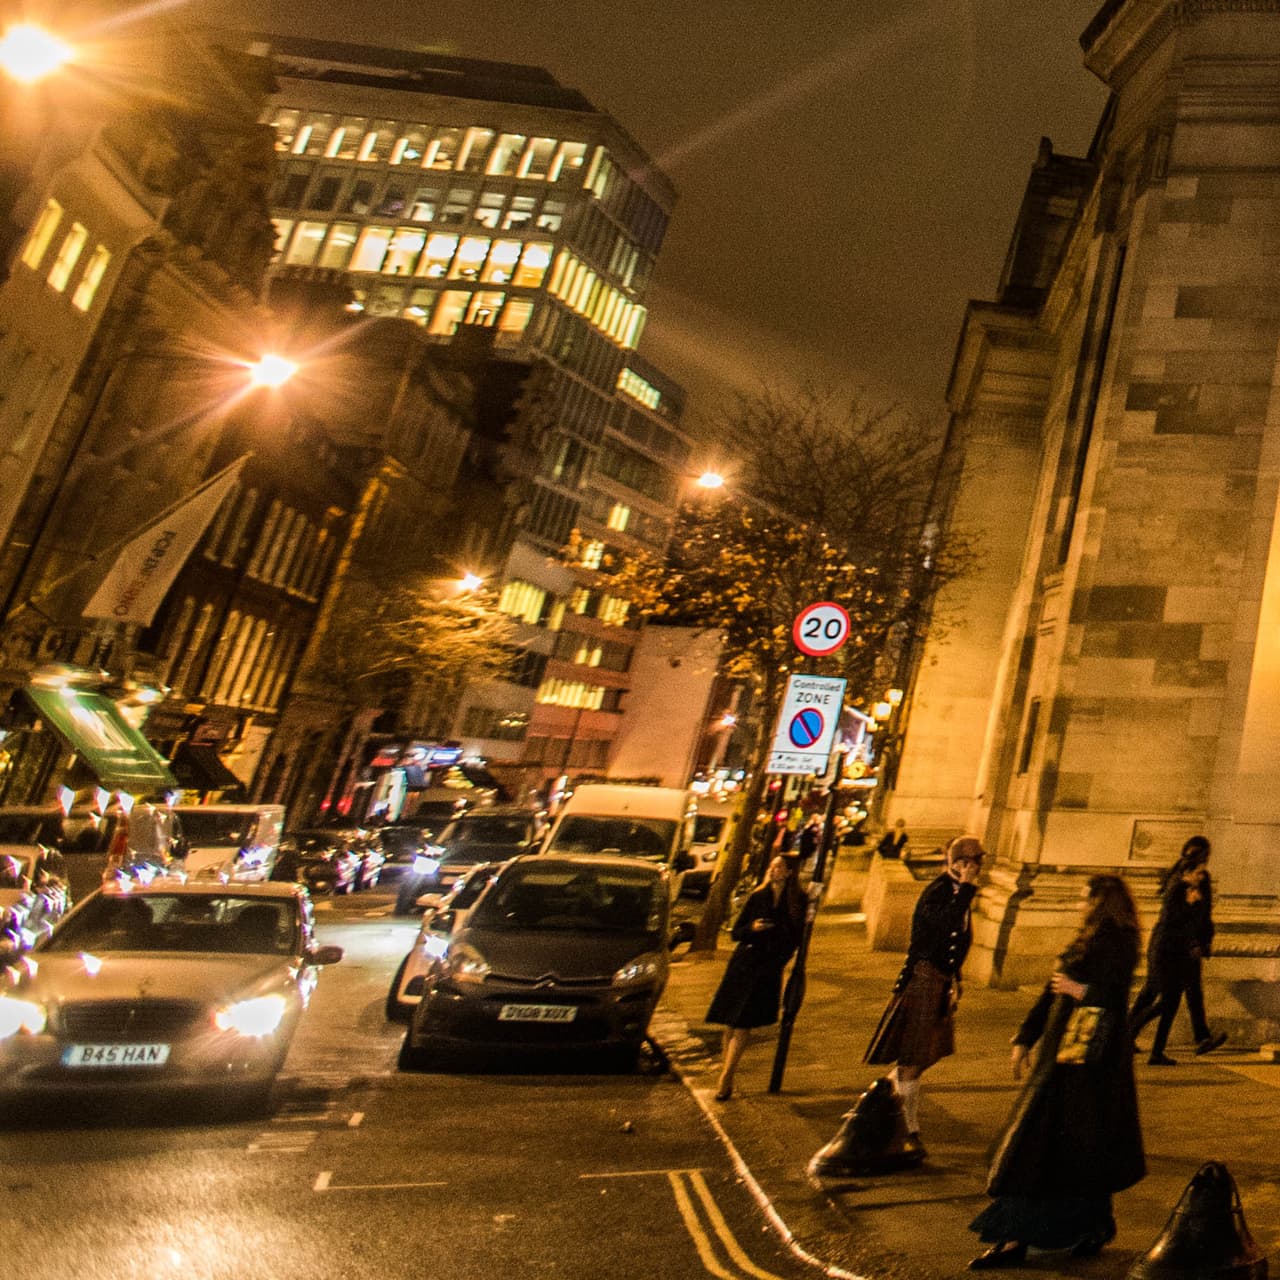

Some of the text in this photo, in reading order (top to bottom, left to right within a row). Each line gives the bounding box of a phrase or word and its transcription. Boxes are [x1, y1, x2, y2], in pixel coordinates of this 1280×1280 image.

[803, 617, 842, 639] 20
[793, 680, 840, 692] Controlled
[796, 692, 831, 705] ZONE
[122, 1046, 161, 1062] HAN
